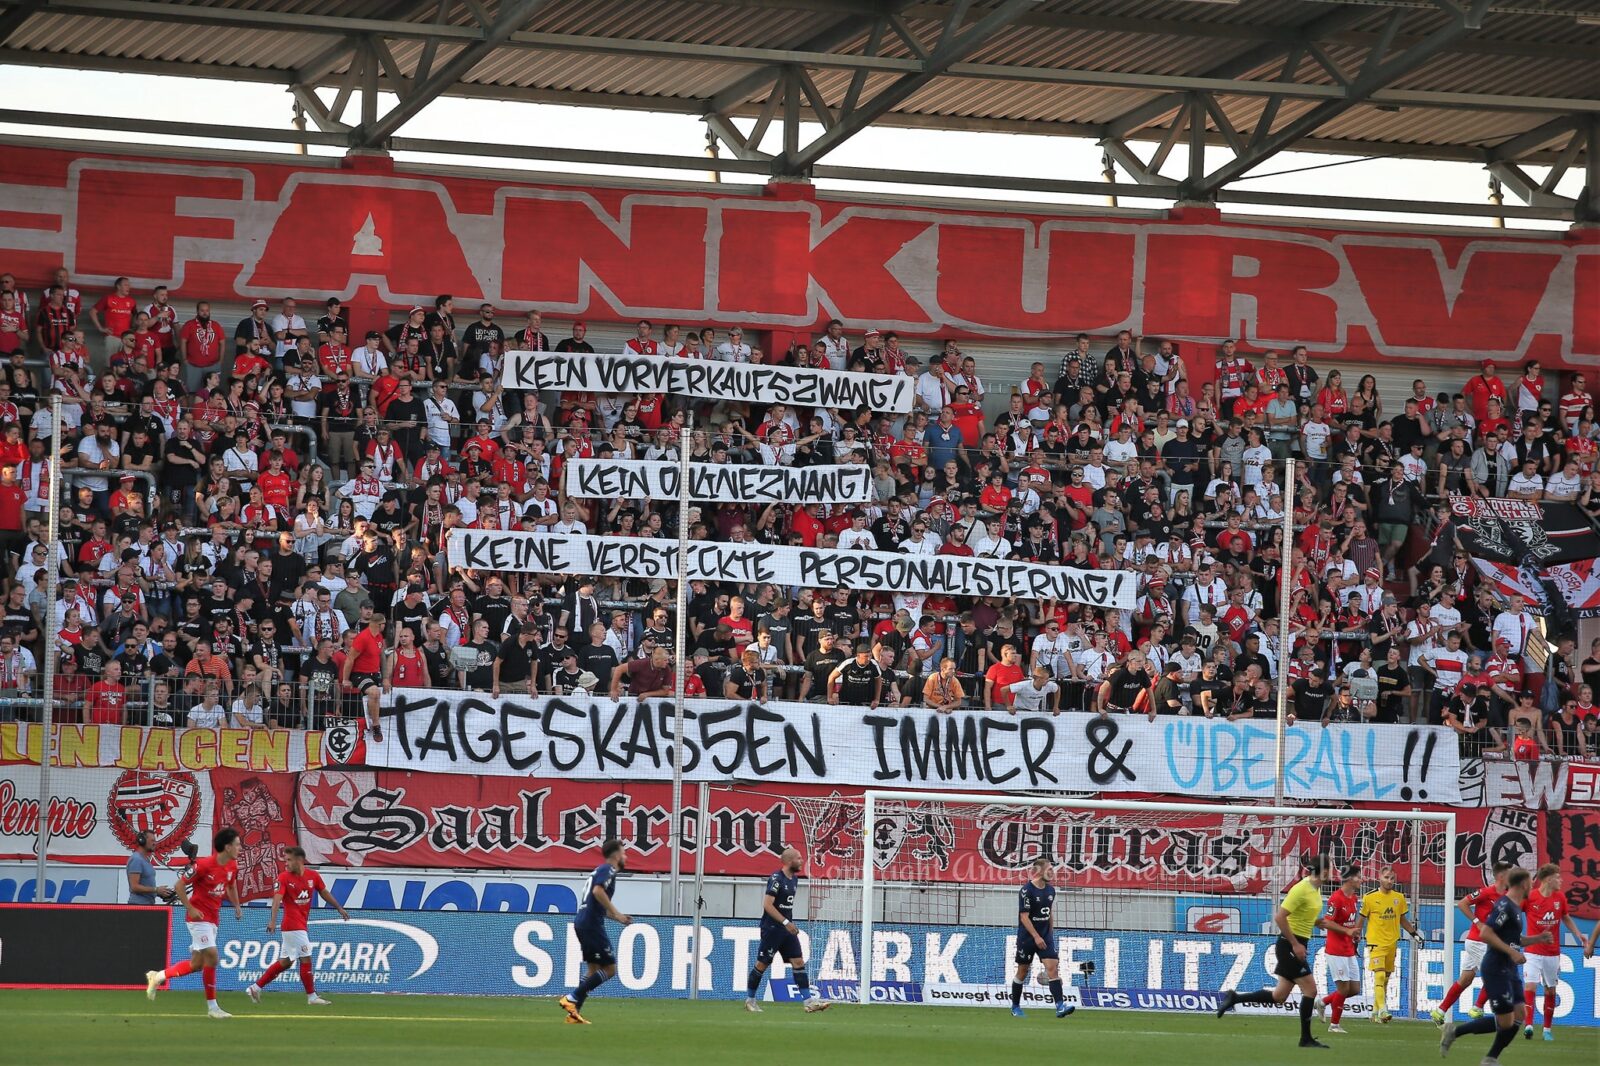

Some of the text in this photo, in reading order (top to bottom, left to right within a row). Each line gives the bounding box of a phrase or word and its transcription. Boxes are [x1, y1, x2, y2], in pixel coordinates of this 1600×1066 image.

[66, 157, 1600, 367] FANKURV
[516, 355, 905, 411] KEIN VORVERKAUFSZWANG!
[578, 463, 871, 502] KEIN ONLINEZWANG!
[464, 533, 1124, 606] KEINE VERSTECKTE PERSONALISIERUNG!
[114, 726, 291, 773] JAGEN
[379, 694, 827, 777] TAGESKASSEN
[863, 714, 1059, 786] IMMER
[1085, 717, 1137, 784] &
[342, 785, 796, 857] Saalefront
[219, 939, 396, 971] SPOPARK
[827, 985, 906, 1001] UNON
[930, 988, 991, 1004] bewegt
[1022, 990, 1079, 1006] Regon
[1097, 991, 1219, 1010] PS UNION
[1342, 994, 1375, 1013] egio
